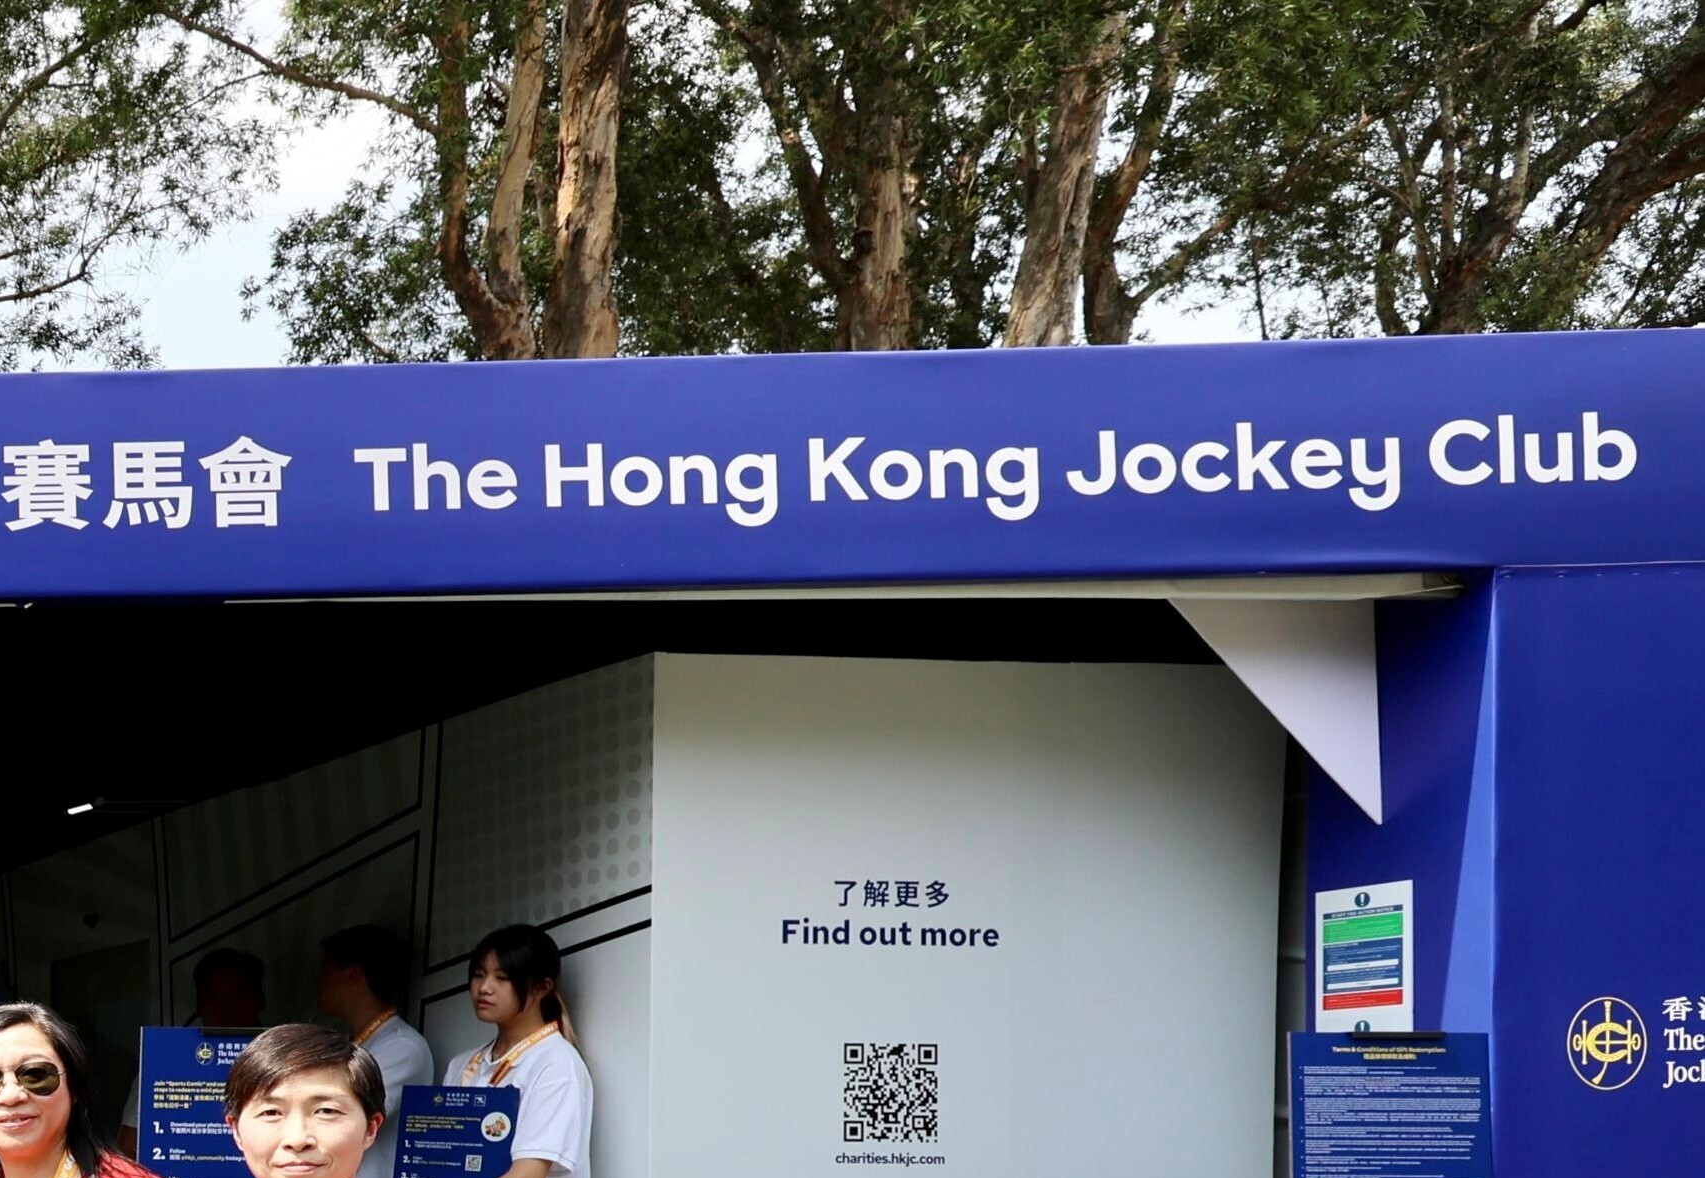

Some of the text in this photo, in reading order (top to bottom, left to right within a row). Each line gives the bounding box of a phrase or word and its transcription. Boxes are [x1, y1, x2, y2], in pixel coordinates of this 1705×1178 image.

[353, 411, 1639, 527] The Hong Kong Jockey Club
[834, 879, 949, 908] 了解更多
[782, 917, 1000, 947] Find out more
[153, 1121, 164, 1134] 1.
[152, 1148, 165, 1160] 2.
[835, 1152, 945, 1167] charities.hkjc.com
